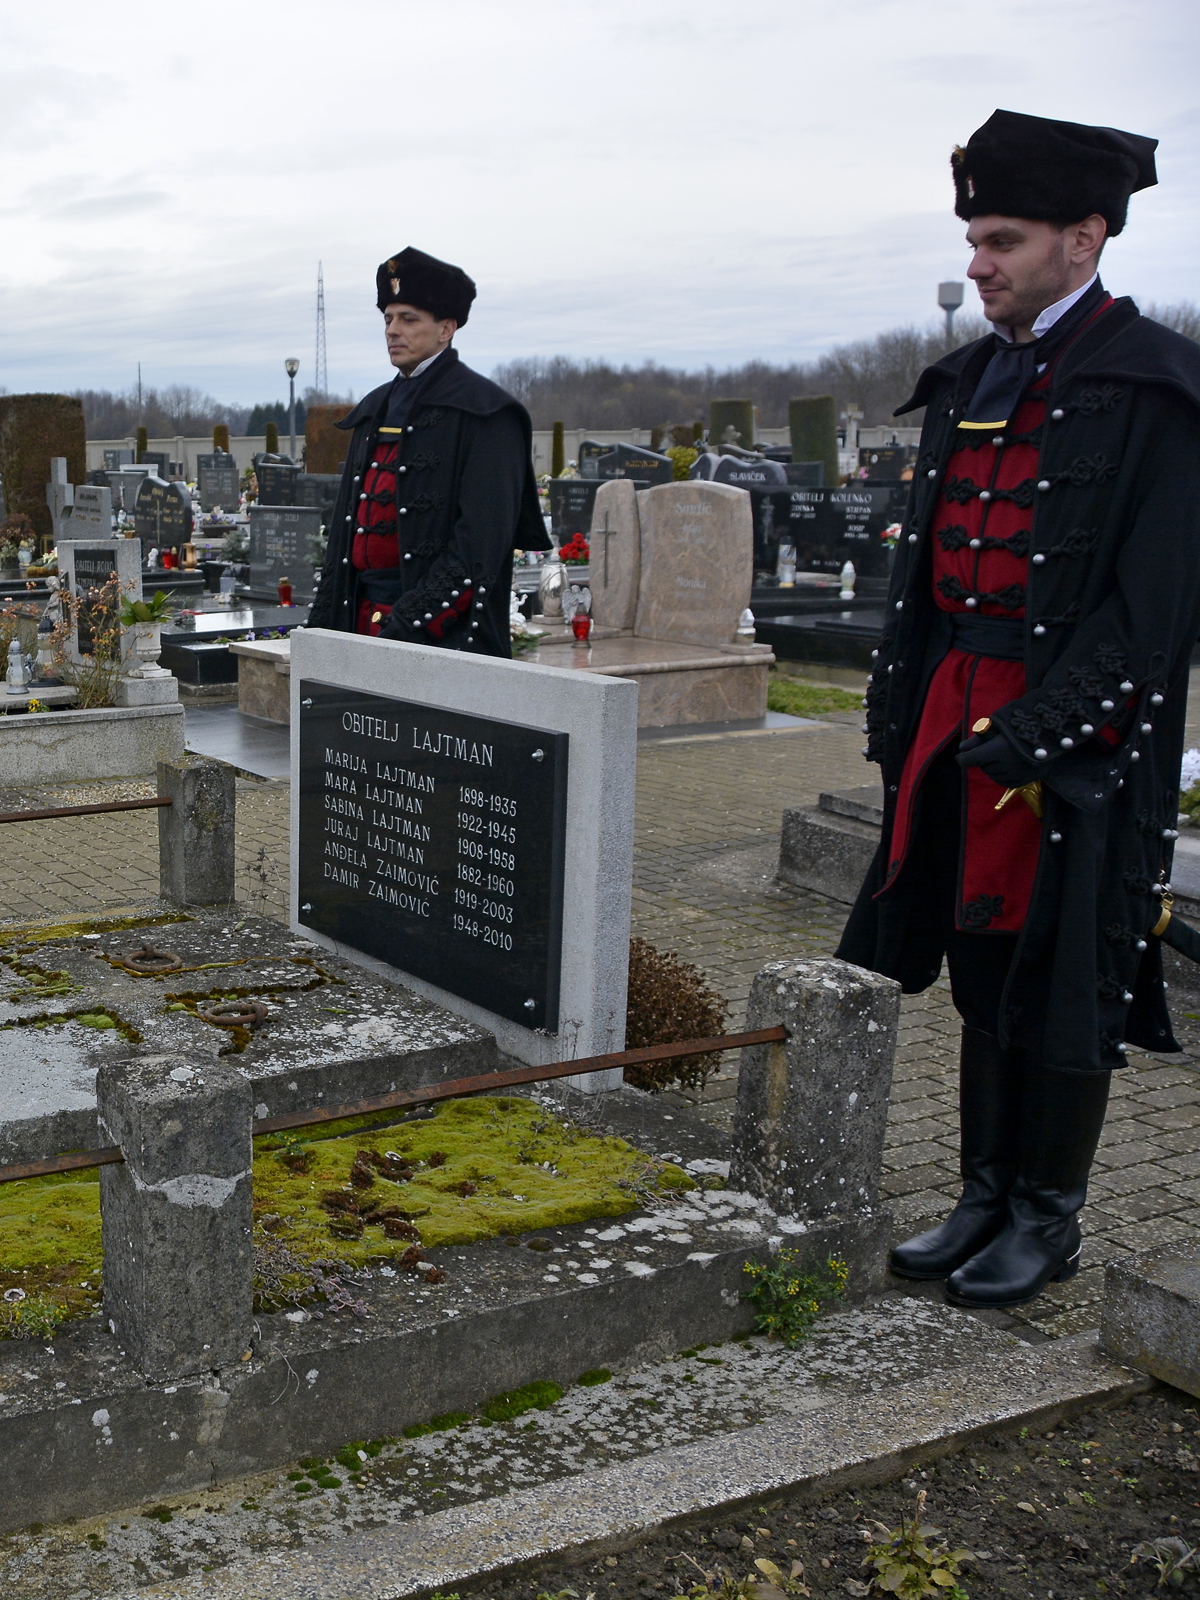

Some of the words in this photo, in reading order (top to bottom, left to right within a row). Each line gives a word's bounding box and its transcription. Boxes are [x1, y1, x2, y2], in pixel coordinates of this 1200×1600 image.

[791, 492, 824, 502] OBITELJ
[830, 493, 872, 503] KOLENKO
[342, 711, 399, 743] OBITELJ
[413, 727, 494, 767] LAJTMAN
[325, 748, 368, 774] MARIJA
[376, 762, 435, 793] LAJTMAN
[459, 786, 517, 817] 1898-1935
[325, 771, 357, 795] MARA
[365, 783, 423, 814] LAJTMAN
[457, 812, 516, 844] 1922-1945
[324, 795, 364, 820] SABINA
[372, 809, 430, 842] LAJTMAN
[457, 837, 515, 871] 1908-1958
[324, 817, 359, 841] JURAJ
[367, 831, 424, 865] LAJTMAN
[457, 863, 514, 897] 1882-1960
[324, 840, 367, 869] ANĐELA
[376, 858, 439, 895] ZAIMOVIĆ
[454, 888, 513, 924] 1919-2003
[324, 862, 359, 889] DAMIR
[368, 880, 430, 918] ZAIMOVIĆ
[453, 914, 513, 951] 1948-2010
